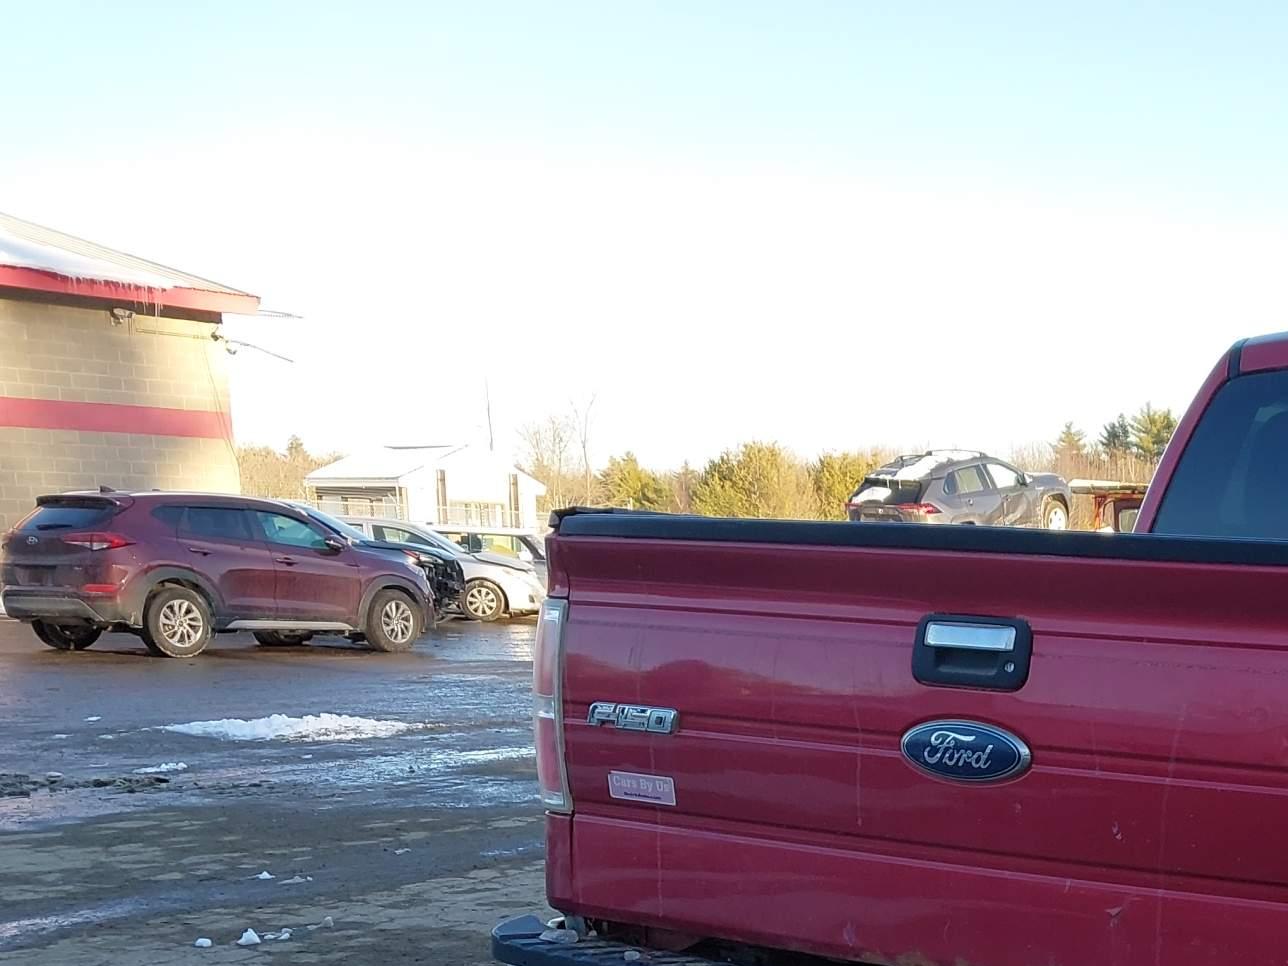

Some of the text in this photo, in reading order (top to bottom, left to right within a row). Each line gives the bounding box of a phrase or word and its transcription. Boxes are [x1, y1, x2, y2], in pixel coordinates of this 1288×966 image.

[924, 731, 994, 769] Ford
[613, 775, 637, 788] Cars
[639, 778, 653, 792] By
